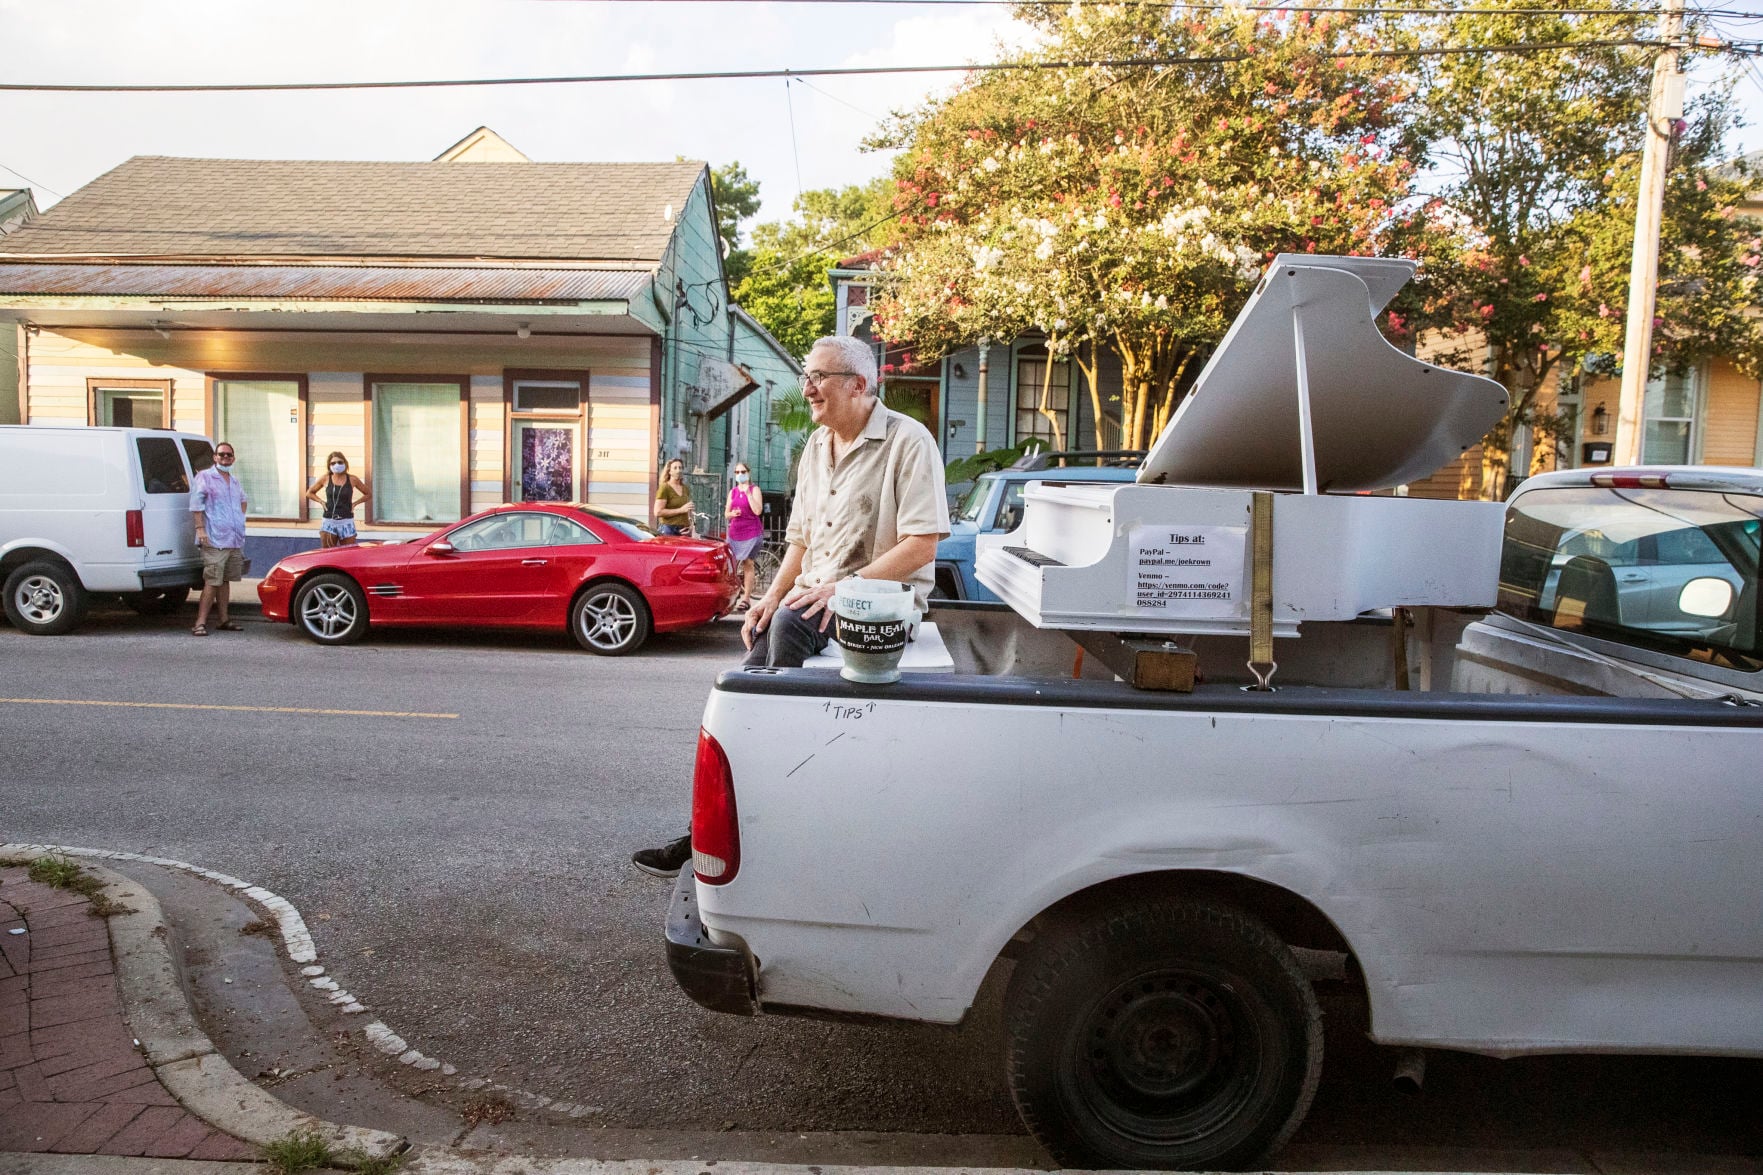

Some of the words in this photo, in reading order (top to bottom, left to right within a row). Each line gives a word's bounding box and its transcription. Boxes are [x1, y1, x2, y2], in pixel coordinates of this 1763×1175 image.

[1169, 533, 1190, 544] Tips
[1192, 534, 1205, 544] at:
[1140, 548, 1164, 556] PayPal
[1139, 558, 1211, 567] paypal.me/joekrown
[1138, 572, 1163, 580] Venmo
[1137, 581, 1229, 591] https://venmo.com/code?
[840, 619, 876, 634] MAPLE
[863, 634, 884, 643] BAR
[834, 705, 863, 719] TIPS
